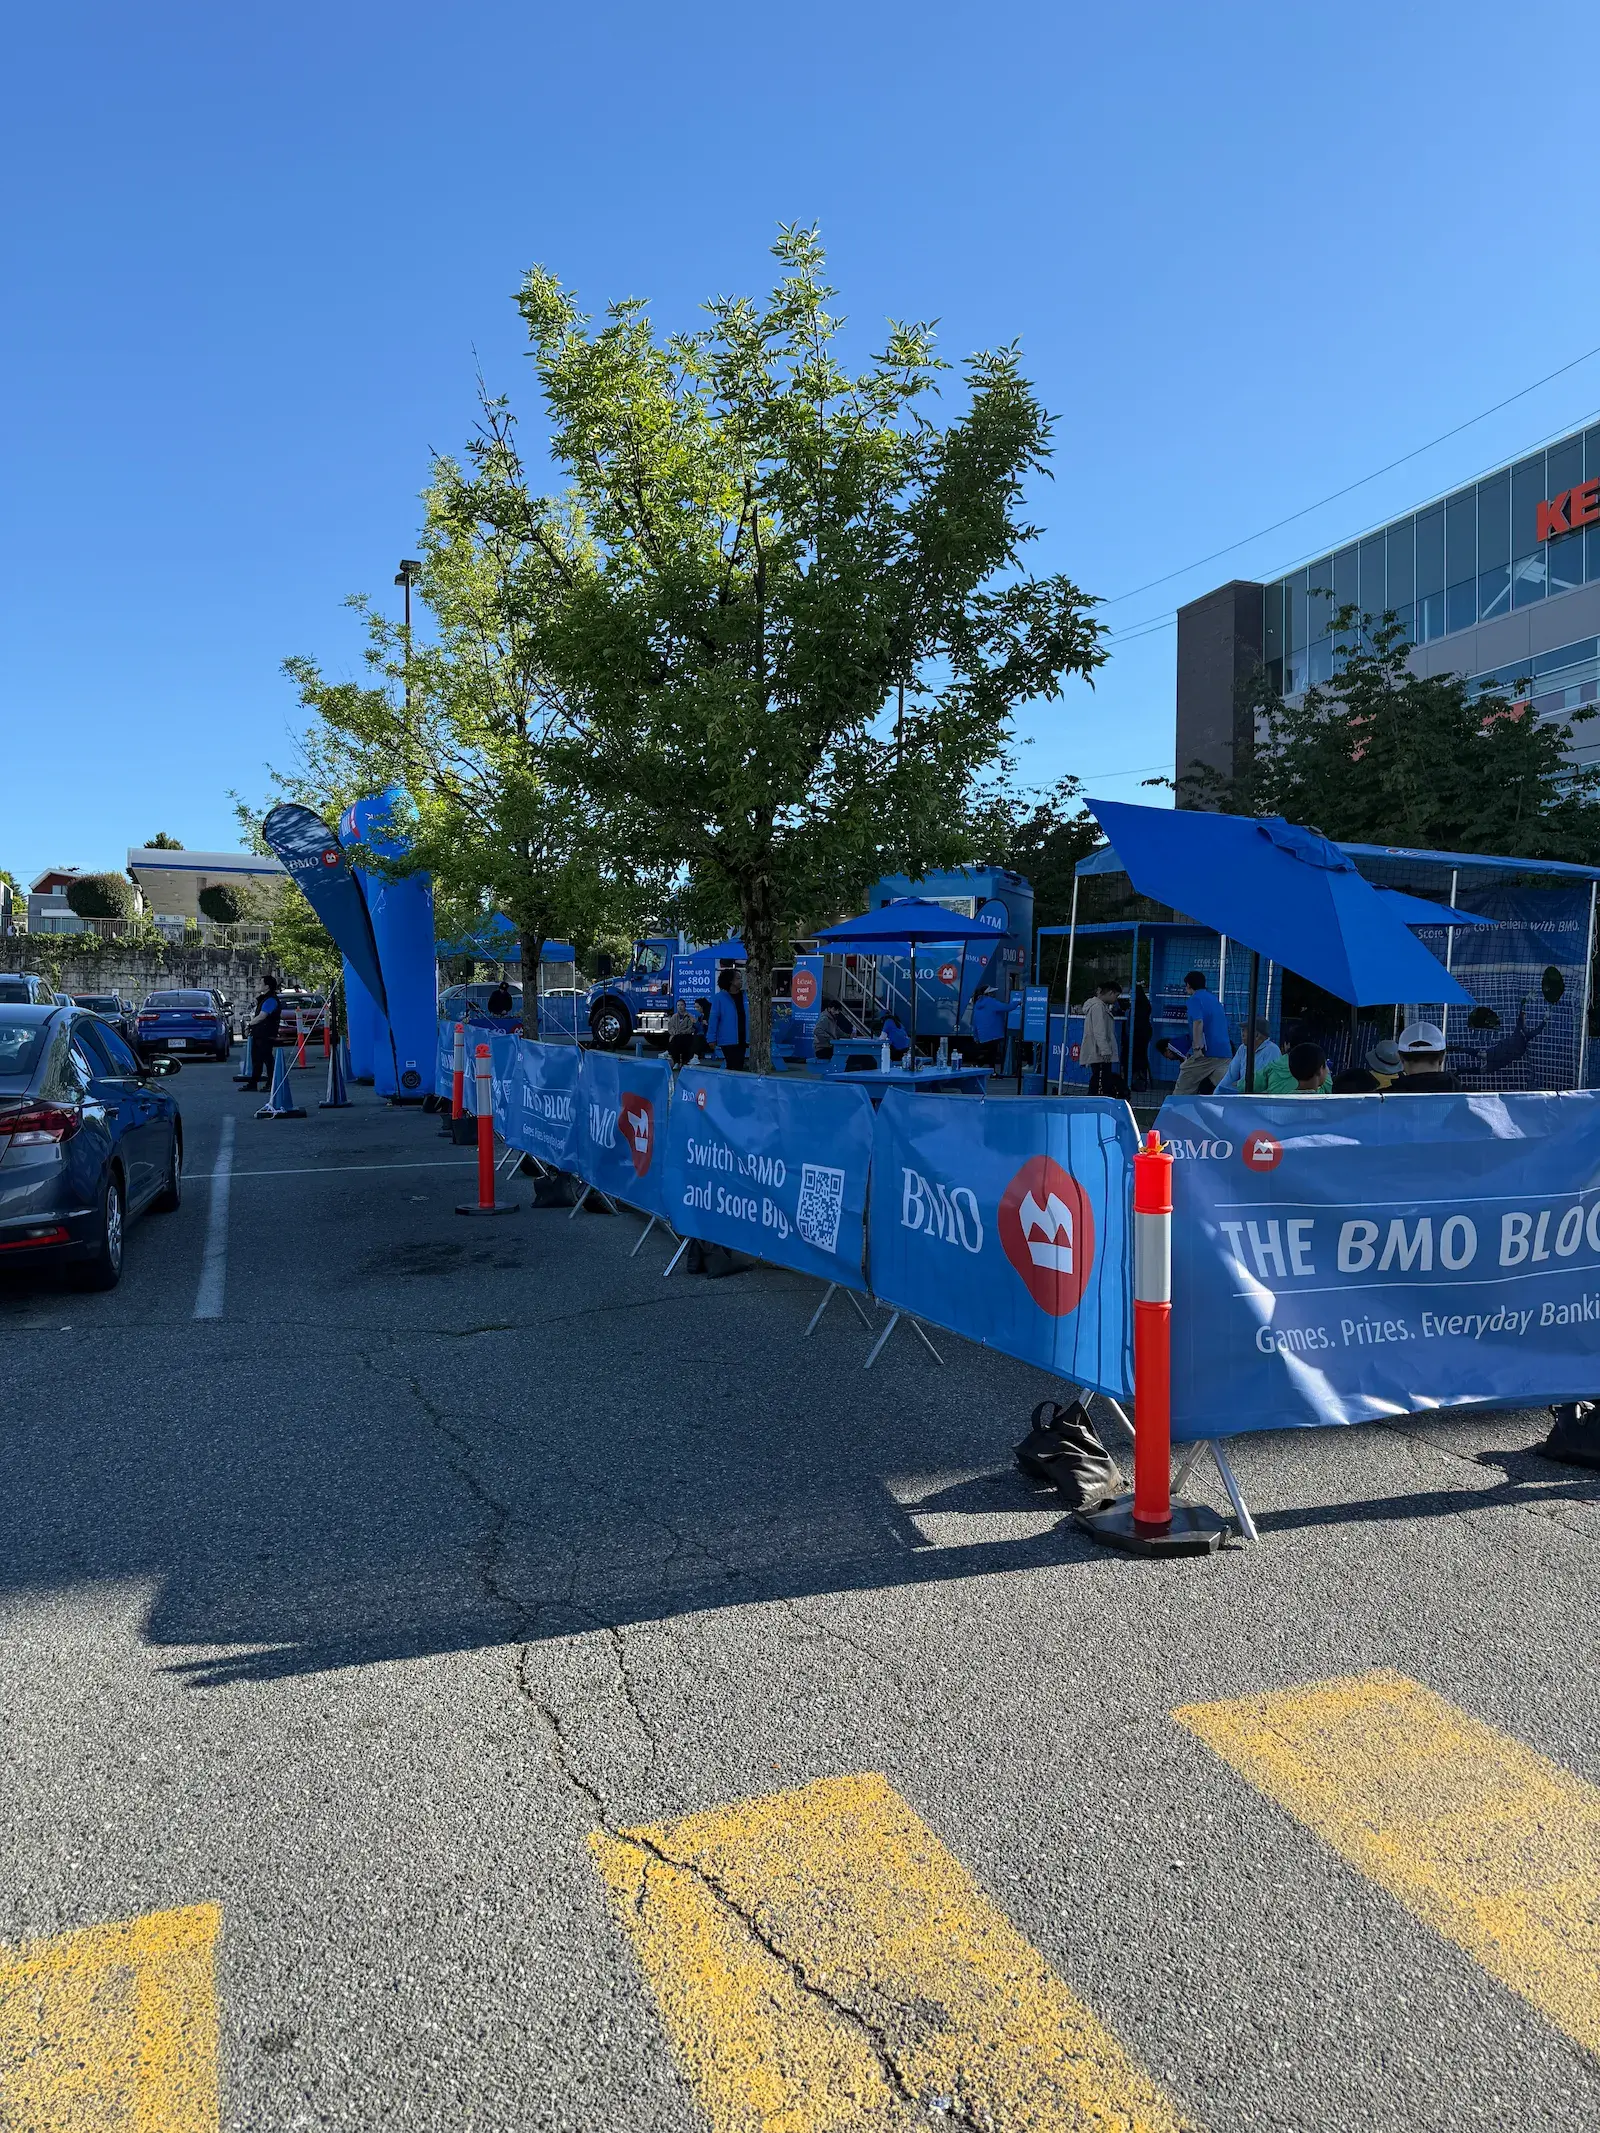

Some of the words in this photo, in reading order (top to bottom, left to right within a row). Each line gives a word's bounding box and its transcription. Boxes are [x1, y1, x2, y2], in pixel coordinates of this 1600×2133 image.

[1537, 477, 1600, 543] KE
[289, 856, 319, 870] BMO
[980, 914, 1002, 929] ATM
[1530, 920, 1556, 932] with
[1418, 927, 1444, 939] Score
[965, 954, 979, 962] BMO
[1003, 948, 1017, 961] BMO
[688, 976, 711, 985] $800
[902, 968, 935, 979] BMO
[687, 1137, 733, 1172] Switch
[1168, 1139, 1234, 1160] BMO
[683, 1181, 712, 1211] and
[716, 1186, 758, 1222] Score
[762, 1198, 794, 1239] Big.
[901, 1167, 984, 1253] BMO
[1219, 1218, 1316, 1279] THE
[1337, 1214, 1478, 1273] BMO
[1255, 1325, 1336, 1354] Games.
[1341, 1314, 1416, 1346] Prizes.
[1423, 1304, 1534, 1339] Everyday
